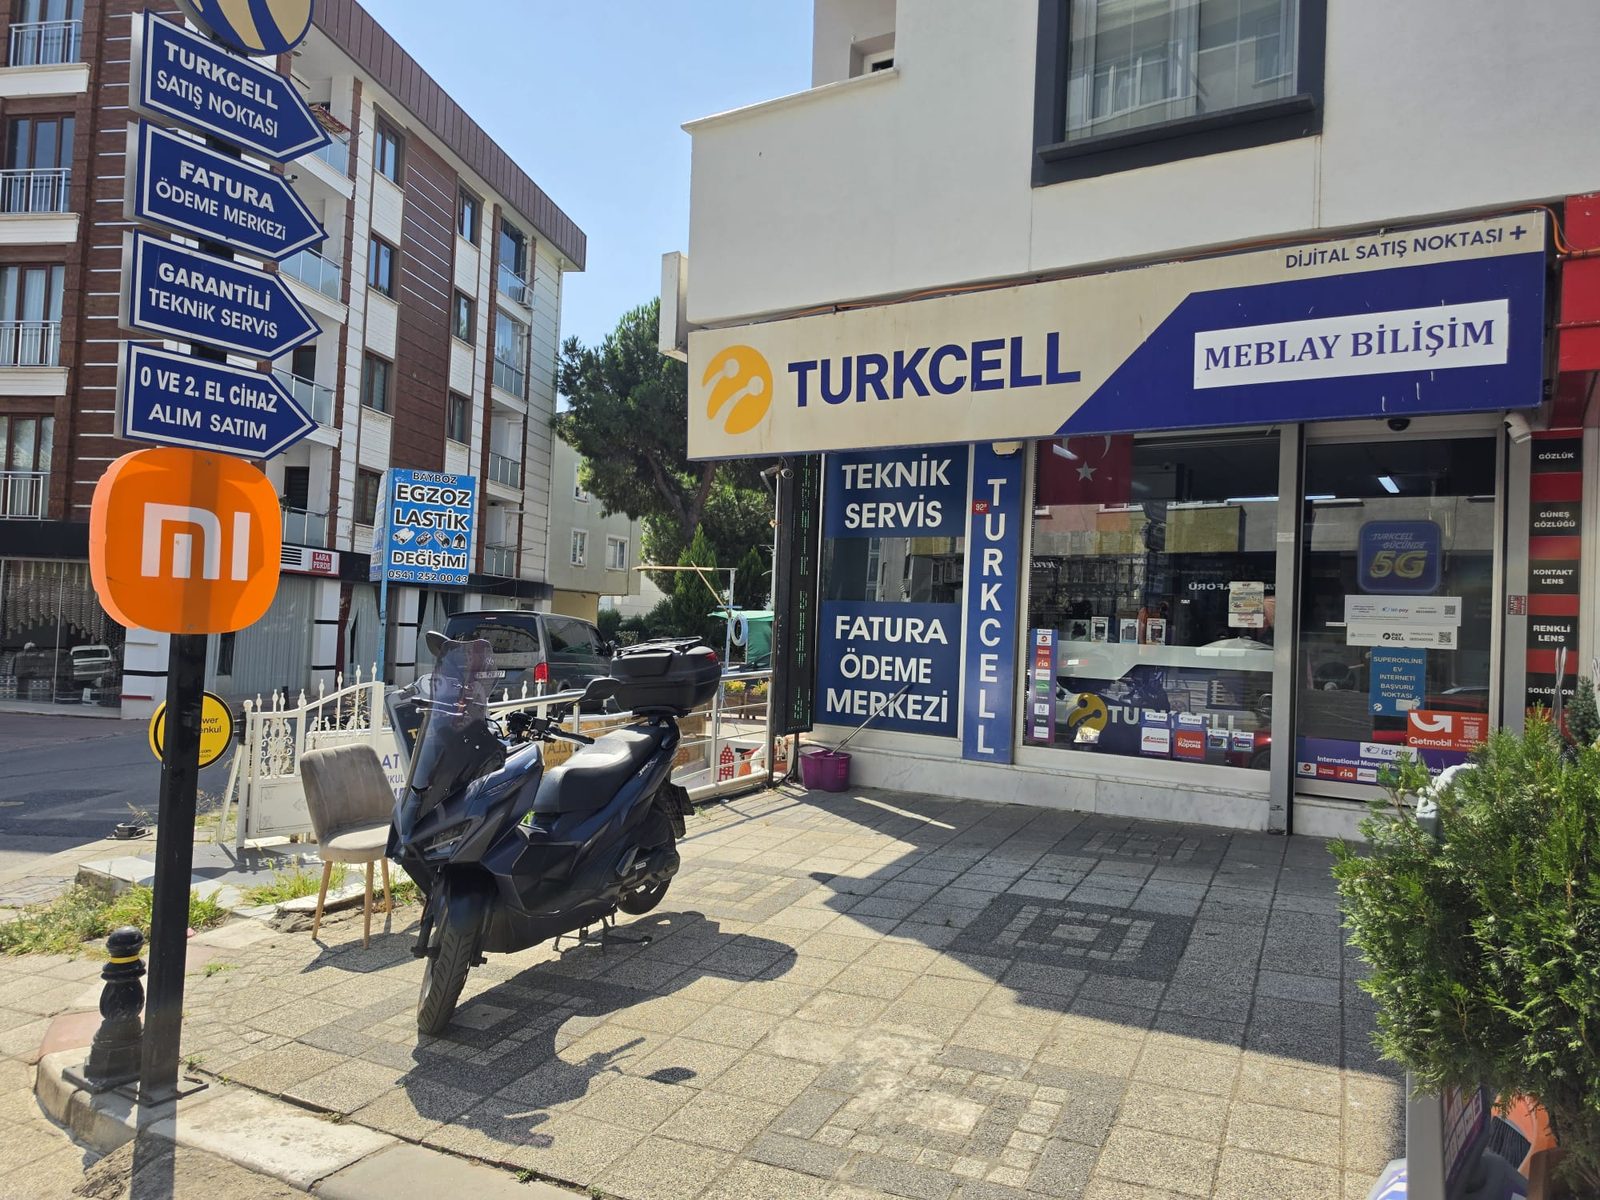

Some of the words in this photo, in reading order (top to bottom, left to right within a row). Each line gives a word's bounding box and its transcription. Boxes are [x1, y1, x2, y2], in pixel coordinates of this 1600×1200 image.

[163, 40, 279, 110] TURKCELL
[157, 70, 203, 110] SATIŞ
[208, 91, 278, 139] NOKTASI
[179, 160, 275, 212] FATURA
[155, 177, 219, 217] ÖDEME
[223, 204, 286, 241] MERKEZİ
[1285, 247, 1350, 269] DİJİTAL
[1355, 239, 1407, 258] SATIŞ
[1413, 228, 1503, 253] NOKTASI
[158, 262, 271, 312] GARANTİLİ
[149, 288, 216, 322] TEKNİK
[220, 309, 278, 339] SERVİS
[1204, 334, 1341, 371] MEBLAY
[1351, 316, 1494, 358] BİLİŞİM
[788, 332, 1081, 408] TURKCELL
[140, 366, 151, 387] 0
[157, 370, 180, 393] VE
[184, 376, 199, 398] 2.
[204, 381, 225, 402] EL
[229, 383, 278, 413] CİHAZ
[148, 403, 201, 428] ALIM
[209, 414, 267, 440] SATIM
[841, 453, 952, 490] TEKNİK
[1538, 451, 1574, 460] GÖZLÜK
[412, 472, 458, 484] BAYBOZ
[396, 483, 472, 508] EGZOZ
[844, 494, 942, 528] SERVİS
[394, 507, 470, 532] LASTİK
[1539, 510, 1570, 519] GÜNEŞ
[388, 570, 414, 579] 0541
[417, 572, 437, 580] 252
[392, 549, 467, 570] DEĞİŞİMİ
[1370, 550, 1428, 579] 5G
[835, 615, 948, 645] FATURA
[977, 478, 1007, 755] TURKCELL
[1533, 624, 1571, 633] RENKLİ
[1538, 634, 1565, 642] LENS
[840, 648, 932, 684] ÖDEME
[826, 688, 948, 723] MERKEZİ
[1527, 686, 1575, 696] SOLÜSON
[1409, 736, 1452, 747] Getmobil
[1317, 755, 1360, 766] International
[1339, 769, 1353, 778] ria
